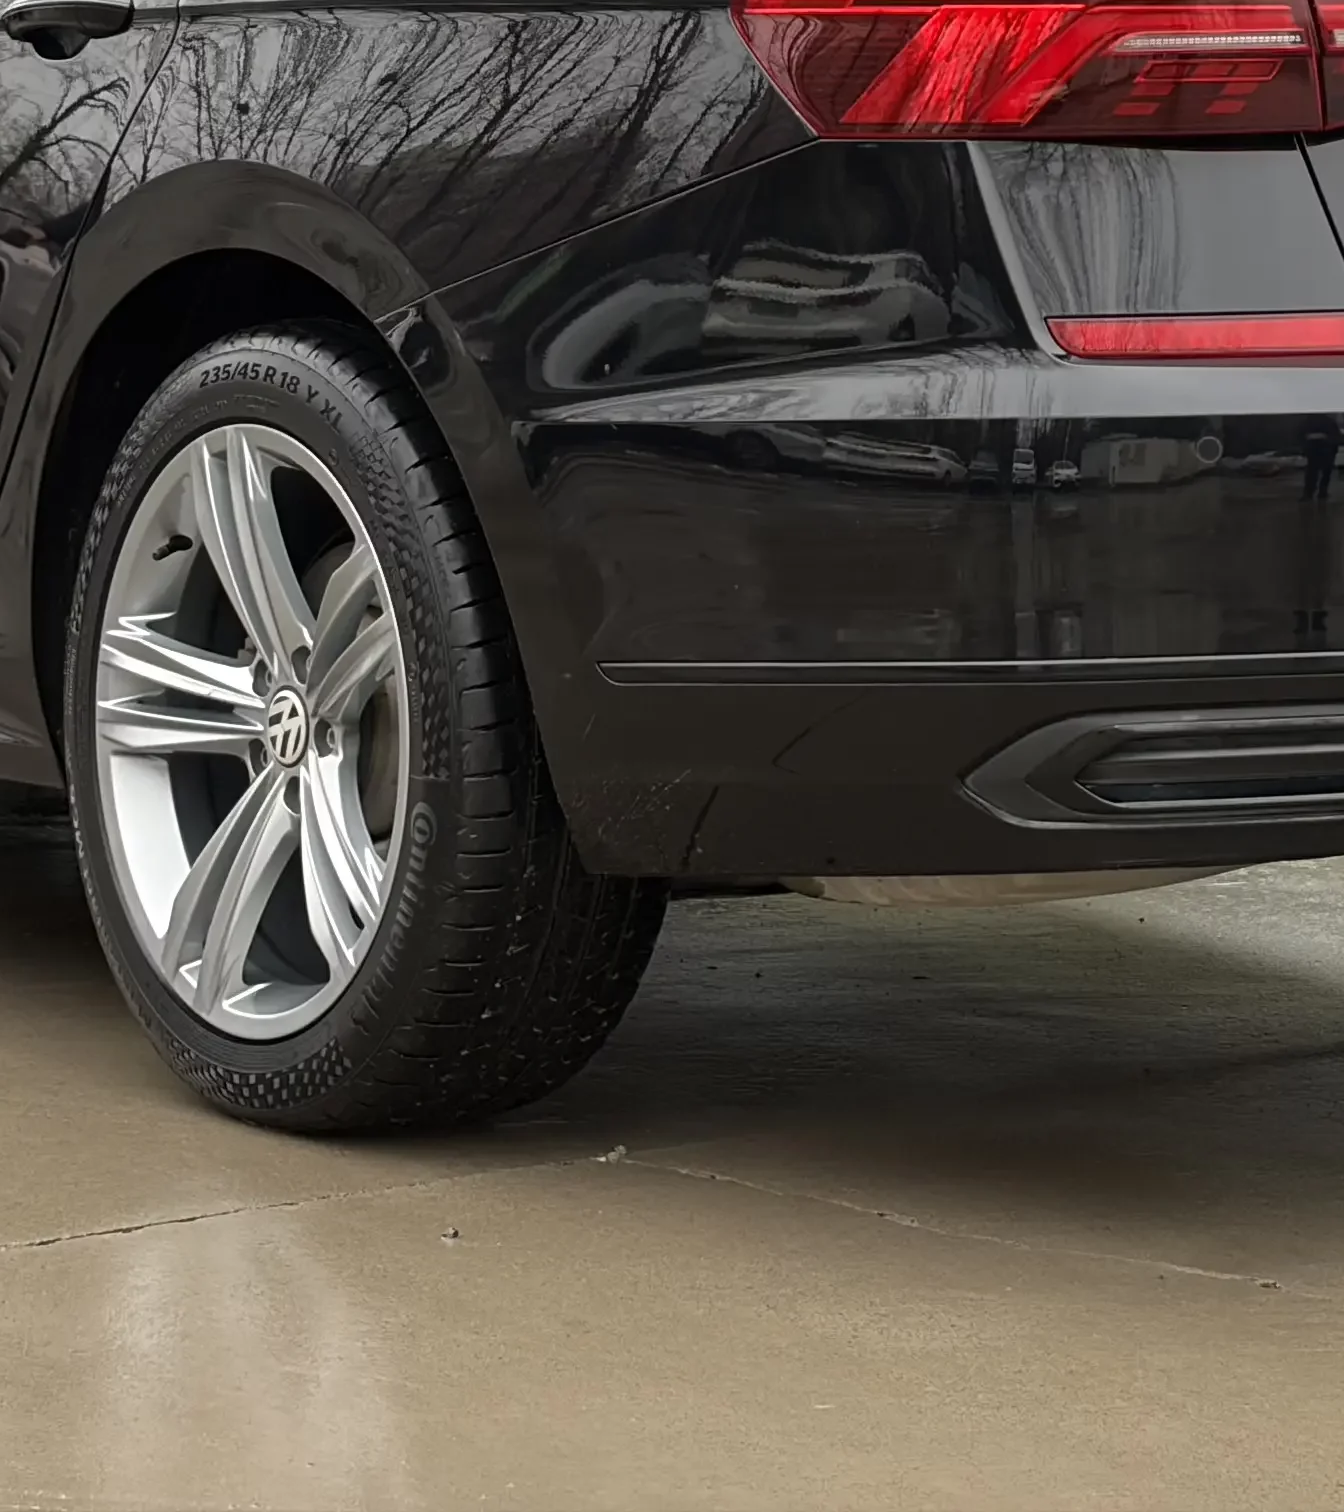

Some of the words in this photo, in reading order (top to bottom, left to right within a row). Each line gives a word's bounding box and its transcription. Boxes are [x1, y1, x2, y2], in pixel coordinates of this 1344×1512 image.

[200, 360, 262, 389] 235/45
[263, 365, 277, 384] R
[279, 371, 301, 394] 18
[306, 384, 320, 404] Y
